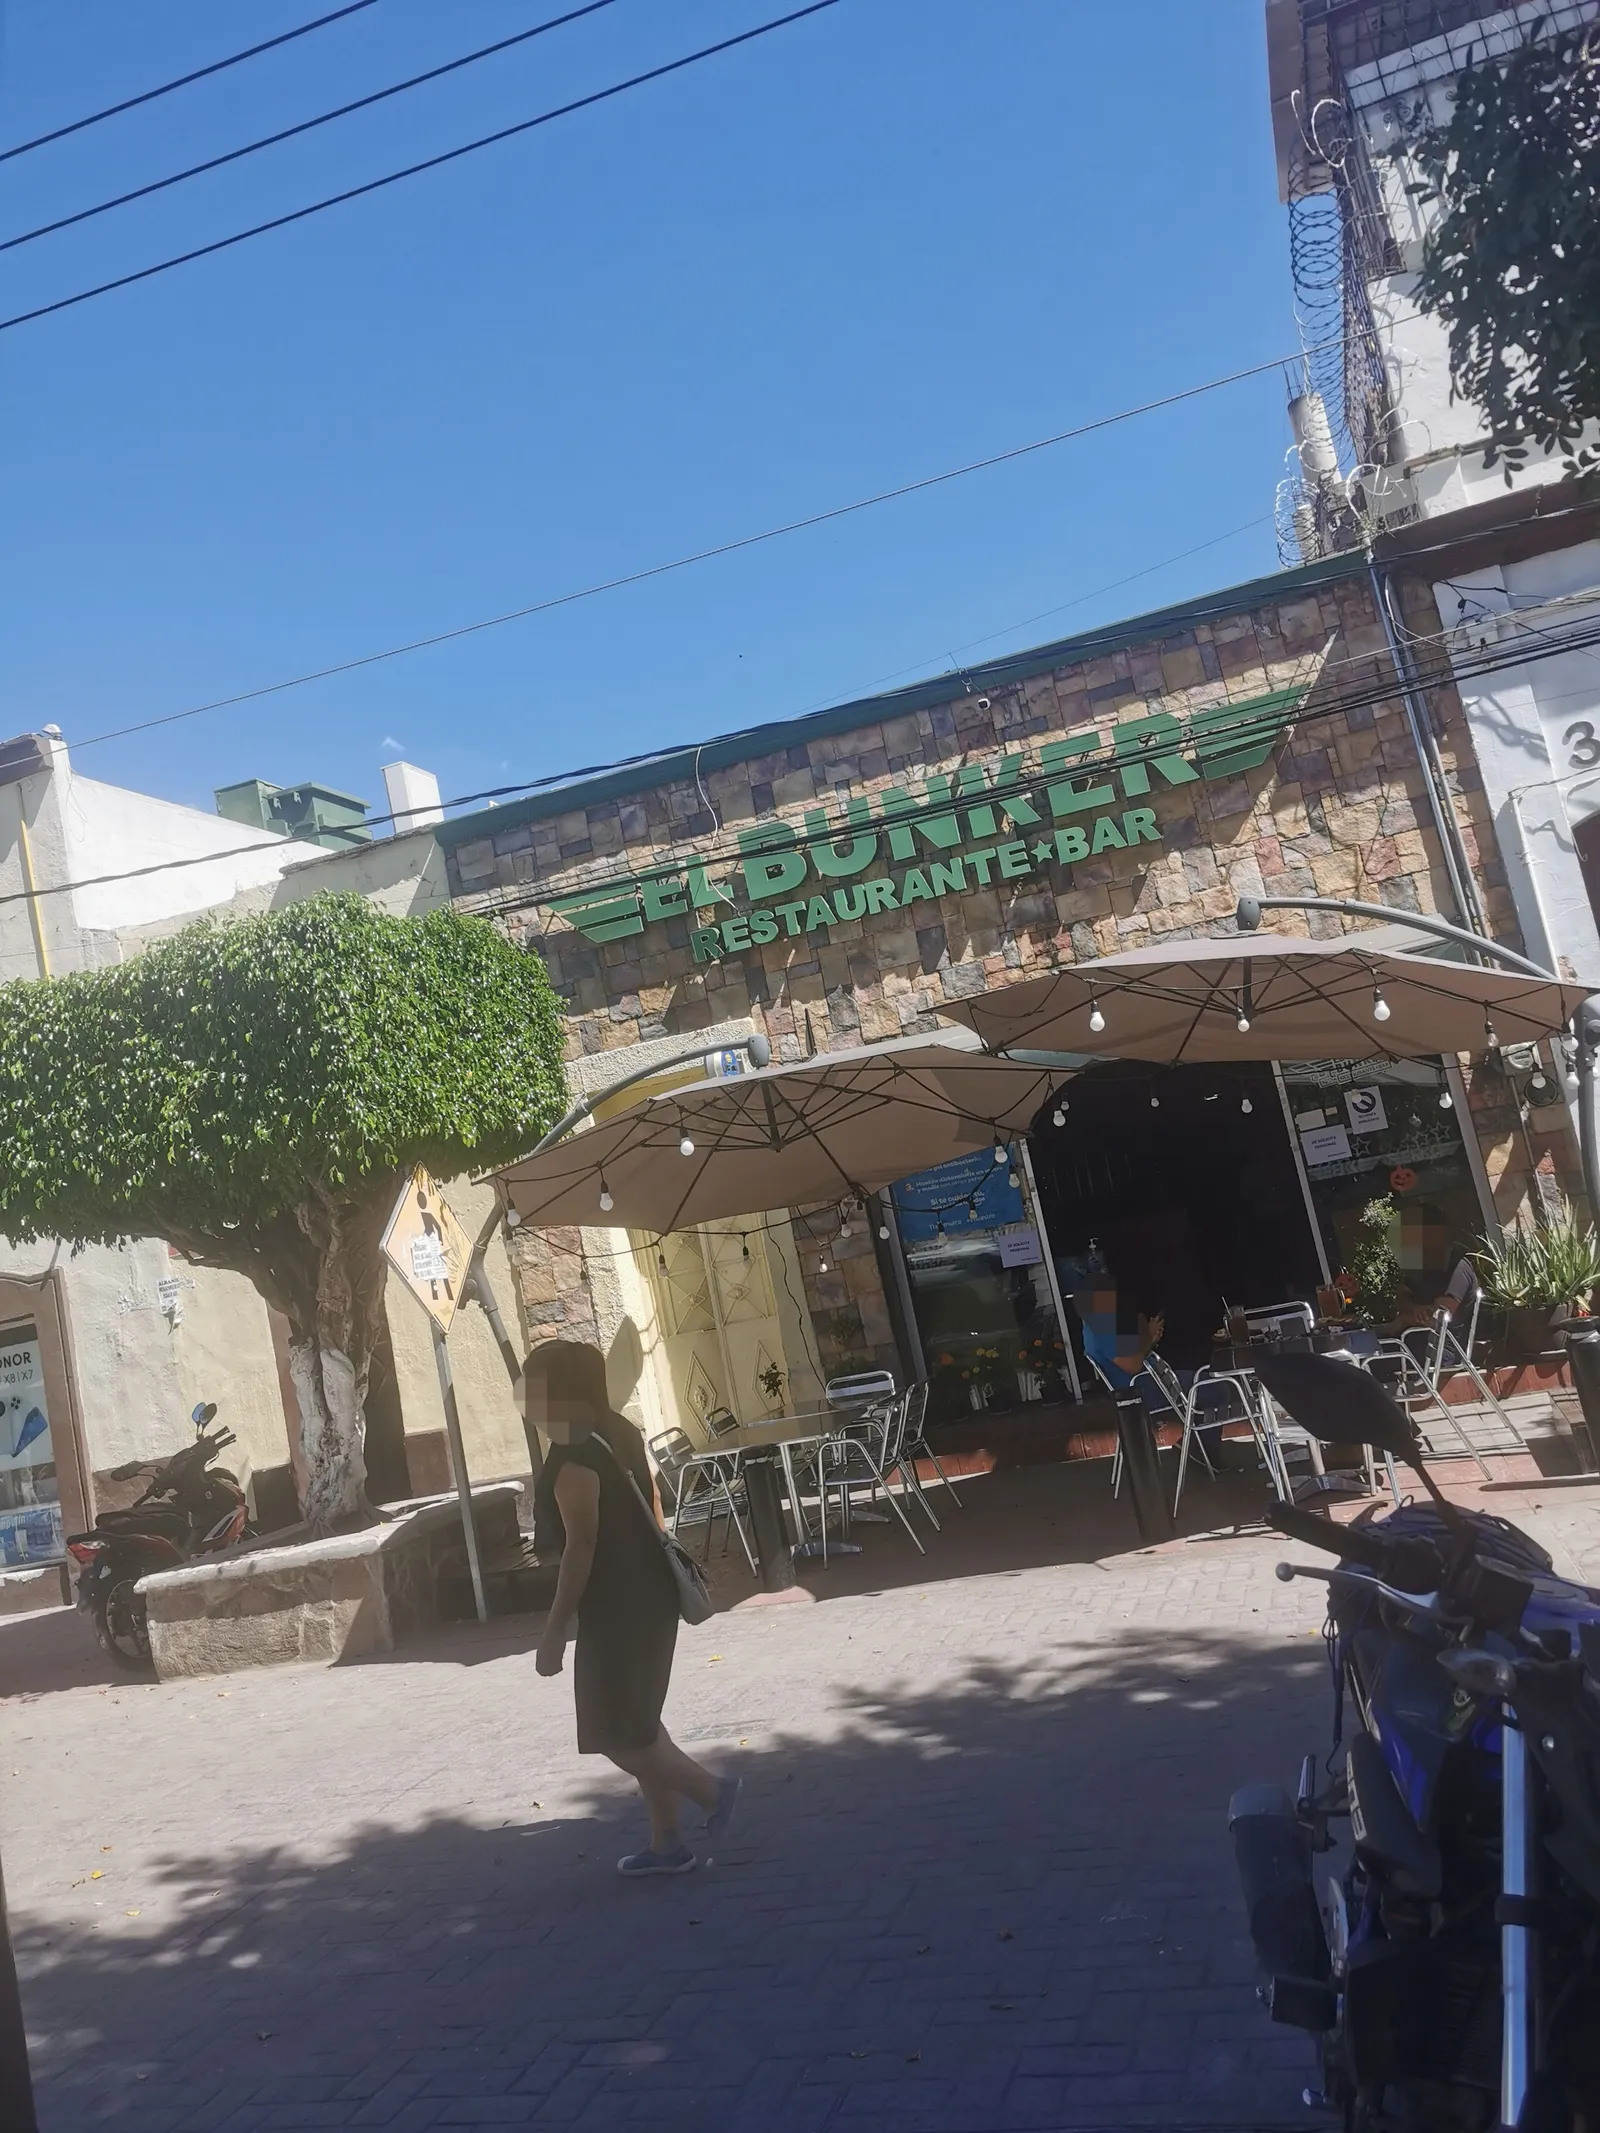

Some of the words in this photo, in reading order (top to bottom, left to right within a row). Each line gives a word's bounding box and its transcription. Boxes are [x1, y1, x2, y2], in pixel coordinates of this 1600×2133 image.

[638, 855, 735, 921] EL
[736, 713, 1201, 901] BUNKER
[690, 839, 1032, 963] RESTAURANTE
[1054, 807, 1164, 865] BAR
